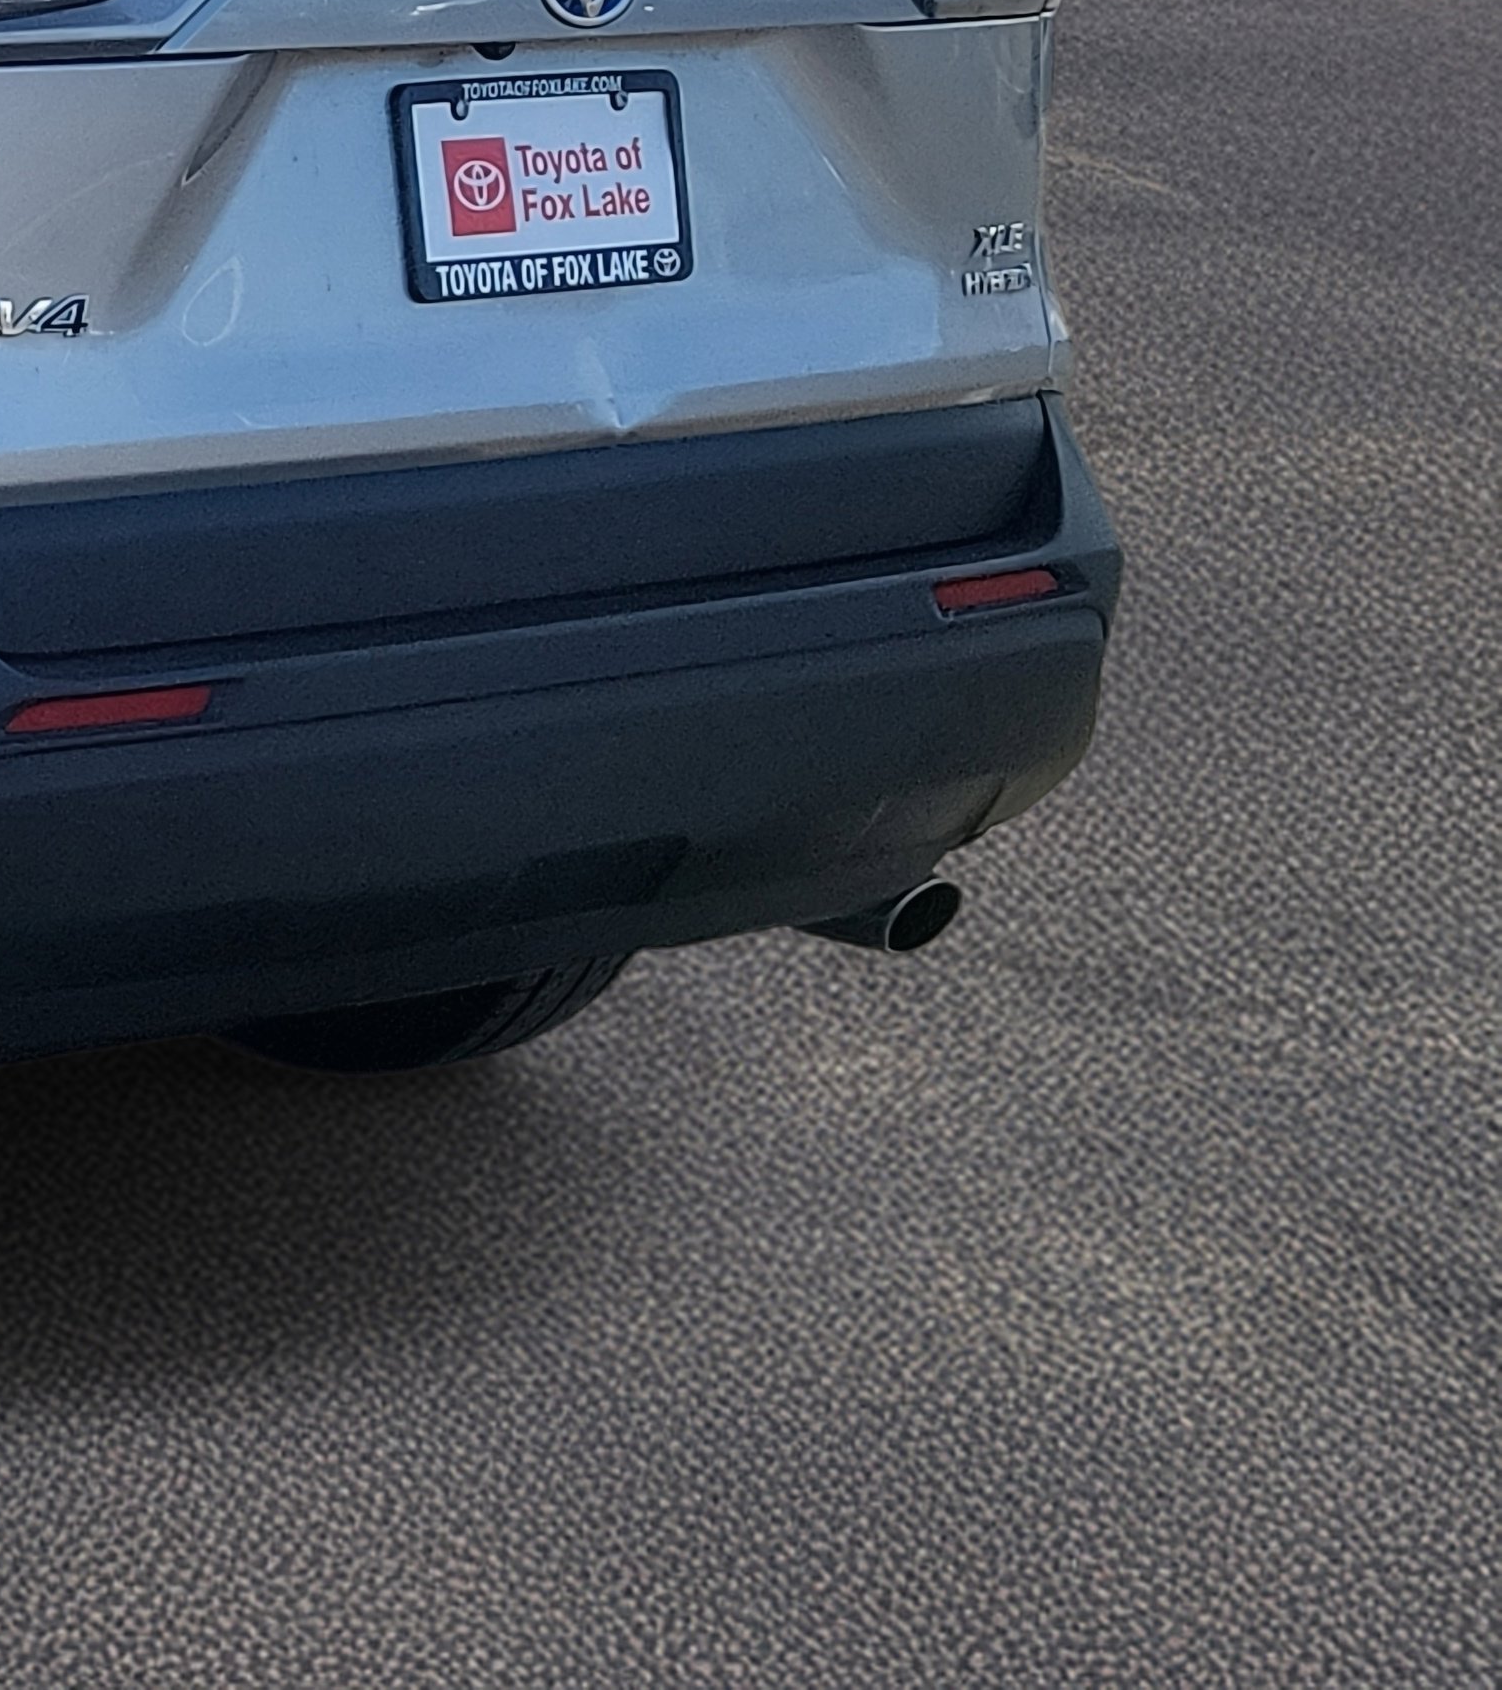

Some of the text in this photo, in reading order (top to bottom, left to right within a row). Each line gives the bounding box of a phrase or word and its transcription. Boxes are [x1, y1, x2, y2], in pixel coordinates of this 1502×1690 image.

[514, 136, 643, 184] Toyota of
[521, 182, 651, 223] Fox Lake
[435, 249, 650, 297] TOYOTA OF FOX LAKE
